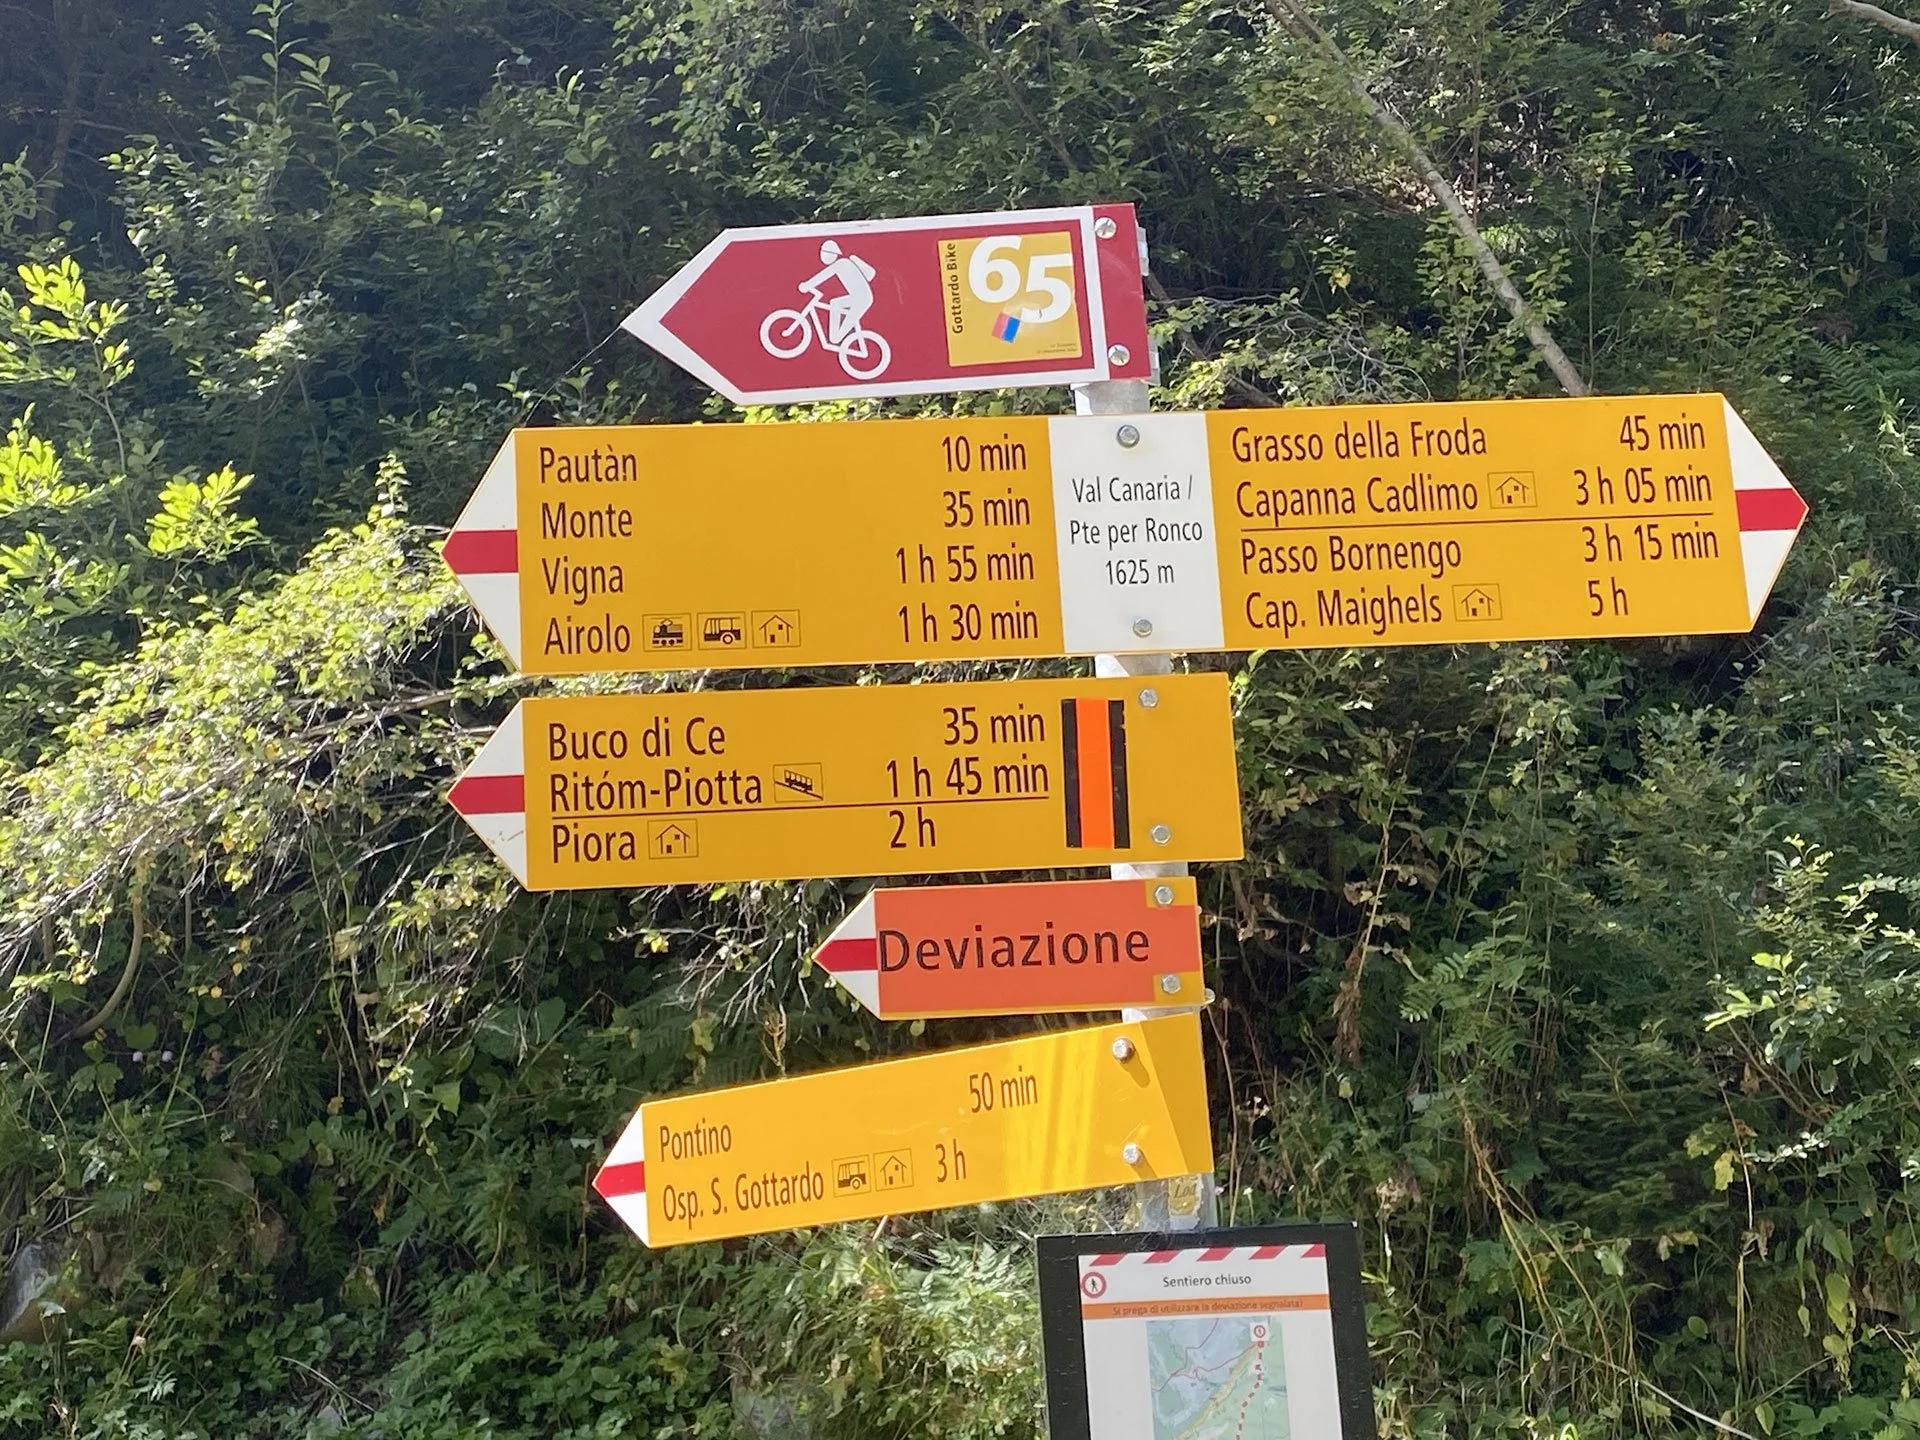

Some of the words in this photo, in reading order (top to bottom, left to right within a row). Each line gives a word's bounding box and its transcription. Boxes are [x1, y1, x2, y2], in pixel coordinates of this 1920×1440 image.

[946, 243, 958, 271] Bike
[968, 235, 1074, 324] 65
[948, 274, 963, 334] Gottardo
[540, 444, 637, 483] Pautàn
[942, 435, 970, 472] 10
[980, 433, 1026, 471] min
[1232, 427, 1323, 462] Grasso
[1335, 420, 1400, 459] della
[1411, 417, 1487, 457] Froda
[1620, 415, 1650, 451] 45
[1658, 413, 1705, 450] min
[542, 502, 632, 539] Monte
[943, 491, 974, 528] 35
[983, 488, 1030, 526] min
[1072, 476, 1101, 503] Val
[1109, 475, 1180, 502] Canaria
[1187, 474, 1193, 500] /
[1236, 481, 1356, 527] Capanna
[1367, 473, 1478, 513] Cadlimo
[1574, 469, 1590, 505] 3
[1597, 466, 1614, 504] h
[1625, 467, 1656, 503] 05
[1665, 464, 1712, 502] min
[1070, 520, 1100, 544] Pte
[1108, 522, 1138, 550] per
[1145, 517, 1202, 543] Ronco
[1241, 538, 1317, 574] Passo
[1329, 535, 1461, 579] Bornengo
[1582, 526, 1597, 562] 3
[1605, 523, 1622, 561] h
[1634, 524, 1662, 560] 15
[1671, 521, 1719, 559] min
[542, 556, 623, 605] Vigna
[896, 548, 906, 583] 1
[919, 544, 934, 582] h
[947, 545, 977, 582] 55
[987, 542, 1034, 580] min
[1105, 559, 1150, 585] 1625
[1157, 563, 1175, 583] m
[544, 613, 630, 655] Airolo
[899, 606, 909, 642] 1
[922, 603, 937, 642] h
[950, 603, 981, 641] 30
[991, 600, 1038, 639] min
[1246, 592, 1306, 639] Cap.
[1317, 584, 1442, 635] Maighels
[1588, 580, 1604, 617] 5
[1611, 576, 1628, 616] h
[549, 722, 627, 761] Buco
[642, 716, 670, 757] di
[686, 716, 725, 755] Ce
[943, 706, 979, 745] 35
[990, 703, 1045, 743] min
[550, 767, 762, 812] Ritóm-Piotta
[886, 760, 899, 798] 1
[913, 756, 932, 797] h
[946, 756, 982, 795] 45
[993, 753, 1049, 793] min
[552, 822, 636, 863] Piora
[889, 810, 906, 848] 2
[917, 806, 936, 847] h
[879, 921, 1149, 972] Deviazione
[660, 1117, 732, 1162] Pontino
[969, 1071, 993, 1113] 50
[1000, 1065, 1038, 1108] min
[663, 1184, 704, 1230] Osp.
[711, 1177, 727, 1215] S.
[735, 1161, 824, 1211] Gottardo
[935, 1143, 948, 1183] 3
[953, 1138, 967, 1181] h
[1123, 1305, 1148, 1317] prega
[1211, 1300, 1258, 1311] deviazione
[1163, 1275, 1212, 1288] Sentiero
[1215, 1273, 1252, 1286] chiuso
